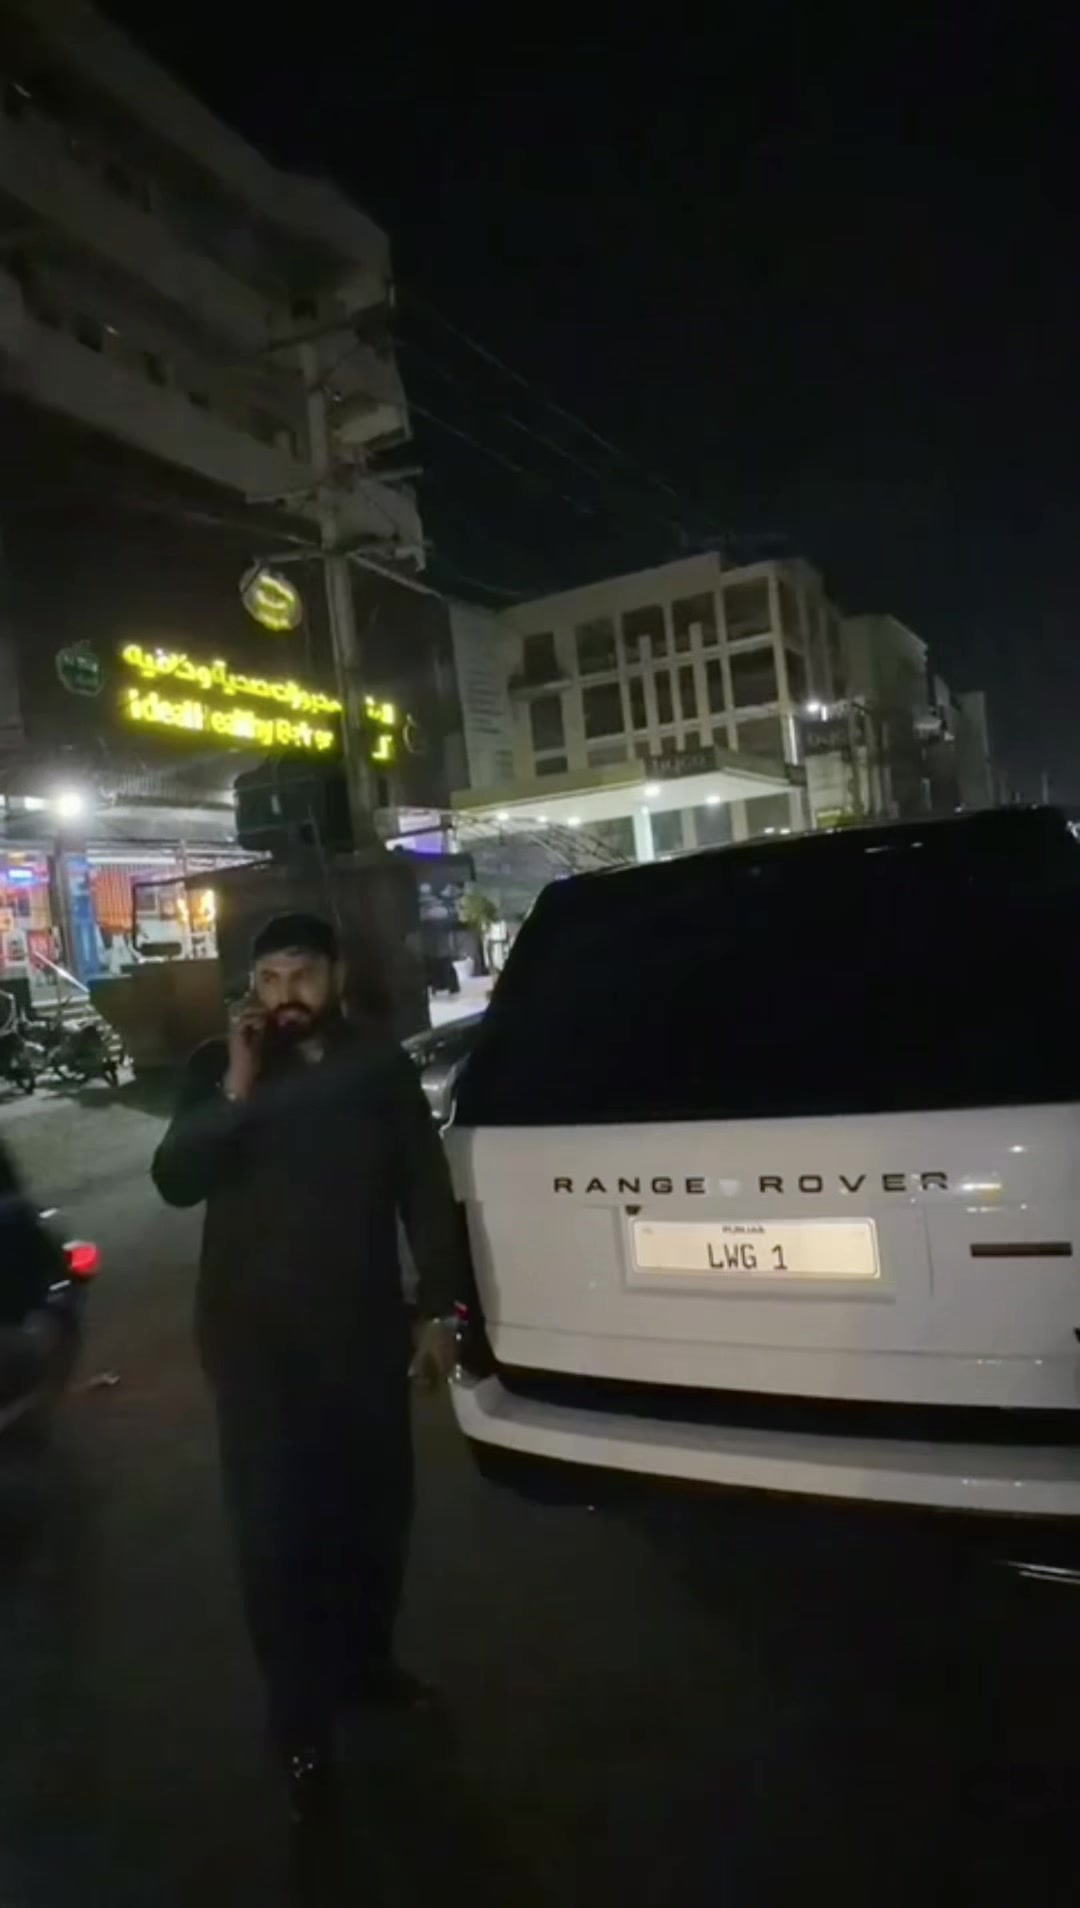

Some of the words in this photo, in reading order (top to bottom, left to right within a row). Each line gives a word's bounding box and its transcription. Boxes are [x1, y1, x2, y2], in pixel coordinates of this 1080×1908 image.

[553, 1176, 705, 1195] RANGE
[759, 1172, 948, 1194] ROVER
[707, 1242, 757, 1270] LWG
[772, 1243, 788, 1270] 1
